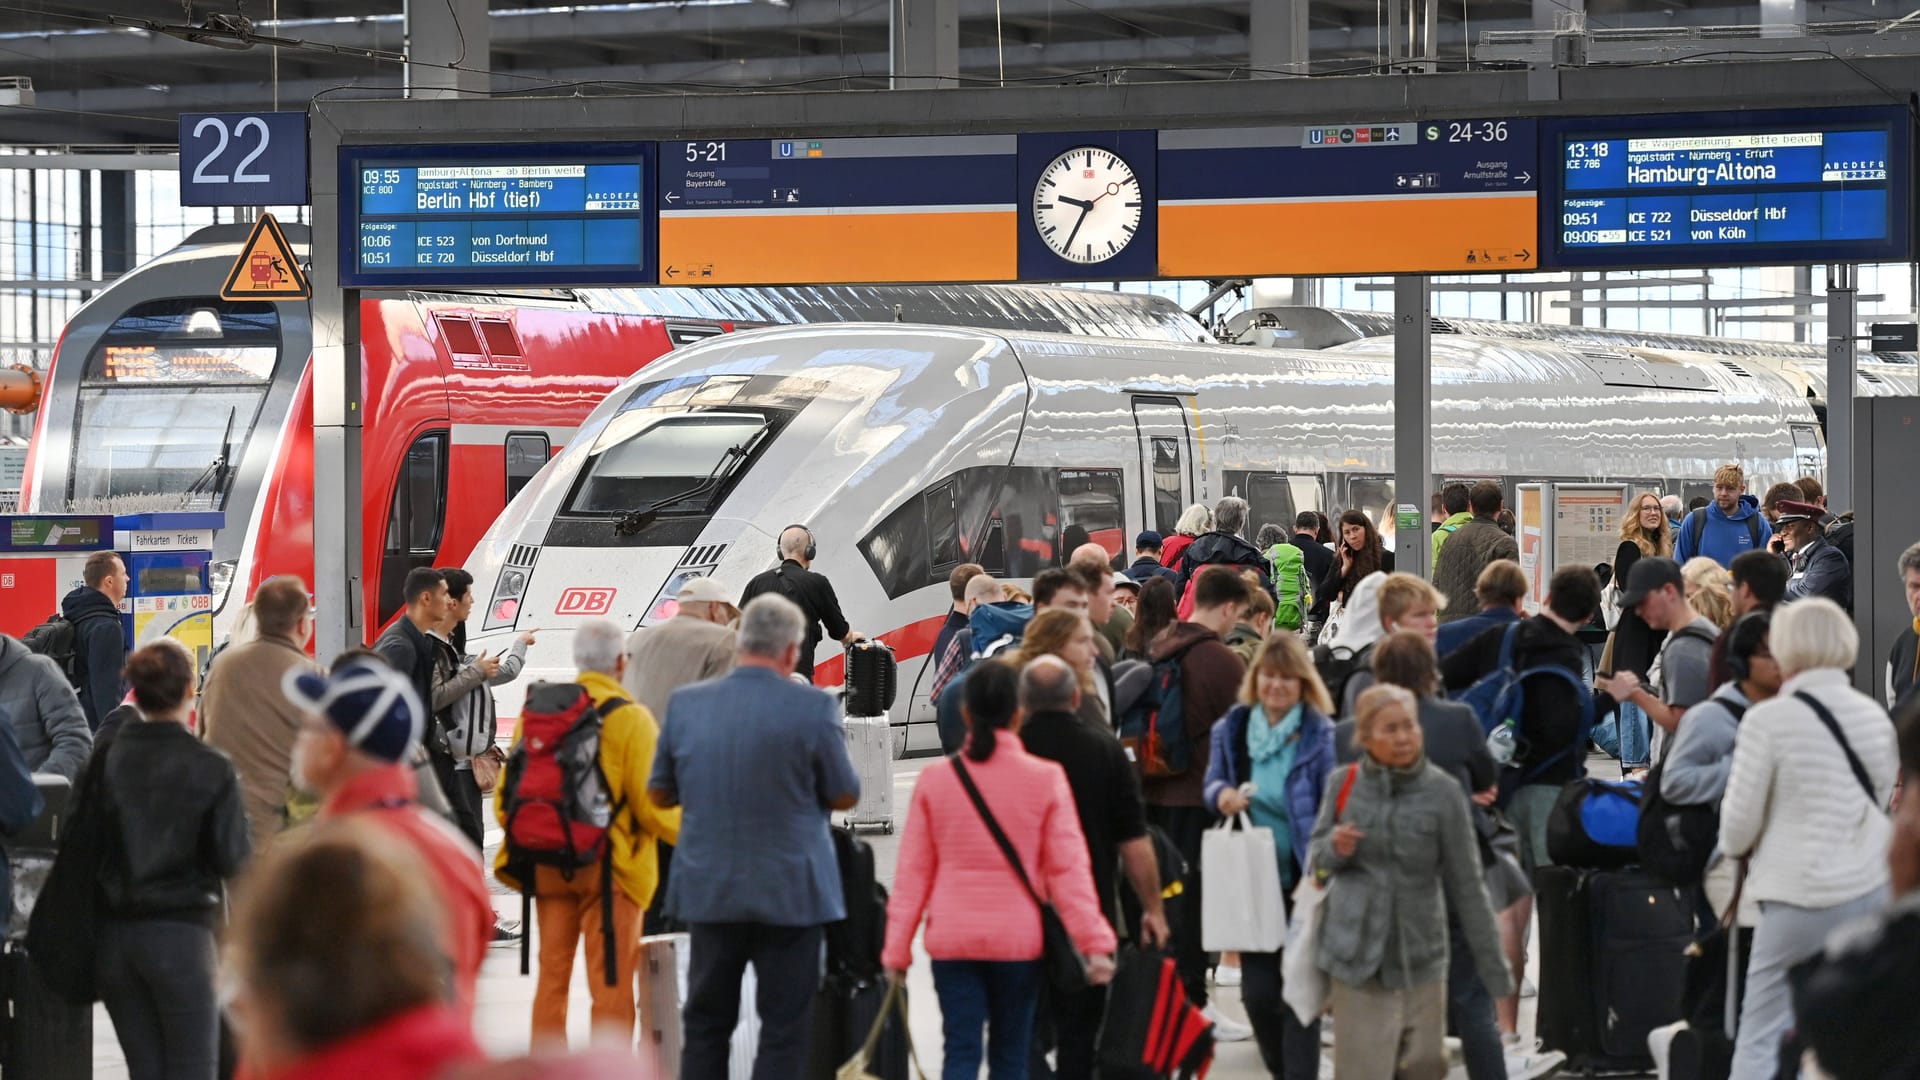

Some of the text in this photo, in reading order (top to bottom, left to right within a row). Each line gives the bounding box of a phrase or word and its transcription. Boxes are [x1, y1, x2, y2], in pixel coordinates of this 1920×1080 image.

[1311, 130, 1321, 144] U
[1449, 121, 1508, 143] 24-36
[192, 117, 270, 183] 22
[686, 142, 726, 162] 5-21
[781, 143, 791, 157] U
[1567, 142, 1608, 158] 13:18
[1628, 152, 1675, 164] Ingolstadt
[1689, 150, 1731, 162] Nürnberg
[1745, 149, 1774, 159] Erfurt
[522, 166, 553, 176] Berlin
[554, 166, 585, 176] weite
[1476, 161, 1508, 170] Ausgang
[1566, 159, 1601, 169] ICE 786
[363, 170, 400, 184] 09:55
[686, 170, 715, 179] Ausgang
[1628, 162, 1776, 186] Hamburg-Altona
[363, 185, 393, 195] ICE 800
[418, 180, 458, 191] Ingolstadt
[470, 179, 507, 190] Nürnberg
[519, 179, 553, 190] Bamberg
[686, 179, 726, 188] Bayerstraße
[418, 191, 541, 209] Berlin Hbf (tief)
[1564, 199, 1606, 208] Folgezüge:
[1563, 207, 1787, 225] 09:51 ICE 722 Düsseldorf Hbf
[361, 223, 397, 231] Folgezüge:
[361, 233, 548, 247] 10:06 ICE 523 von Dortmund
[1563, 231, 1599, 244] 09:06
[1629, 230, 1646, 241] ICE
[1651, 230, 1671, 241] 521
[1691, 230, 1713, 240] von
[1719, 226, 1746, 239] Köln
[361, 250, 555, 264] 10:51 ICE 720 Düsseldorf Hbf
[136, 534, 198, 545] Fahrkarten Tickets
[3, 576, 14, 586] DB
[191, 596, 209, 609] ÖBB
[560, 590, 609, 612] DB
